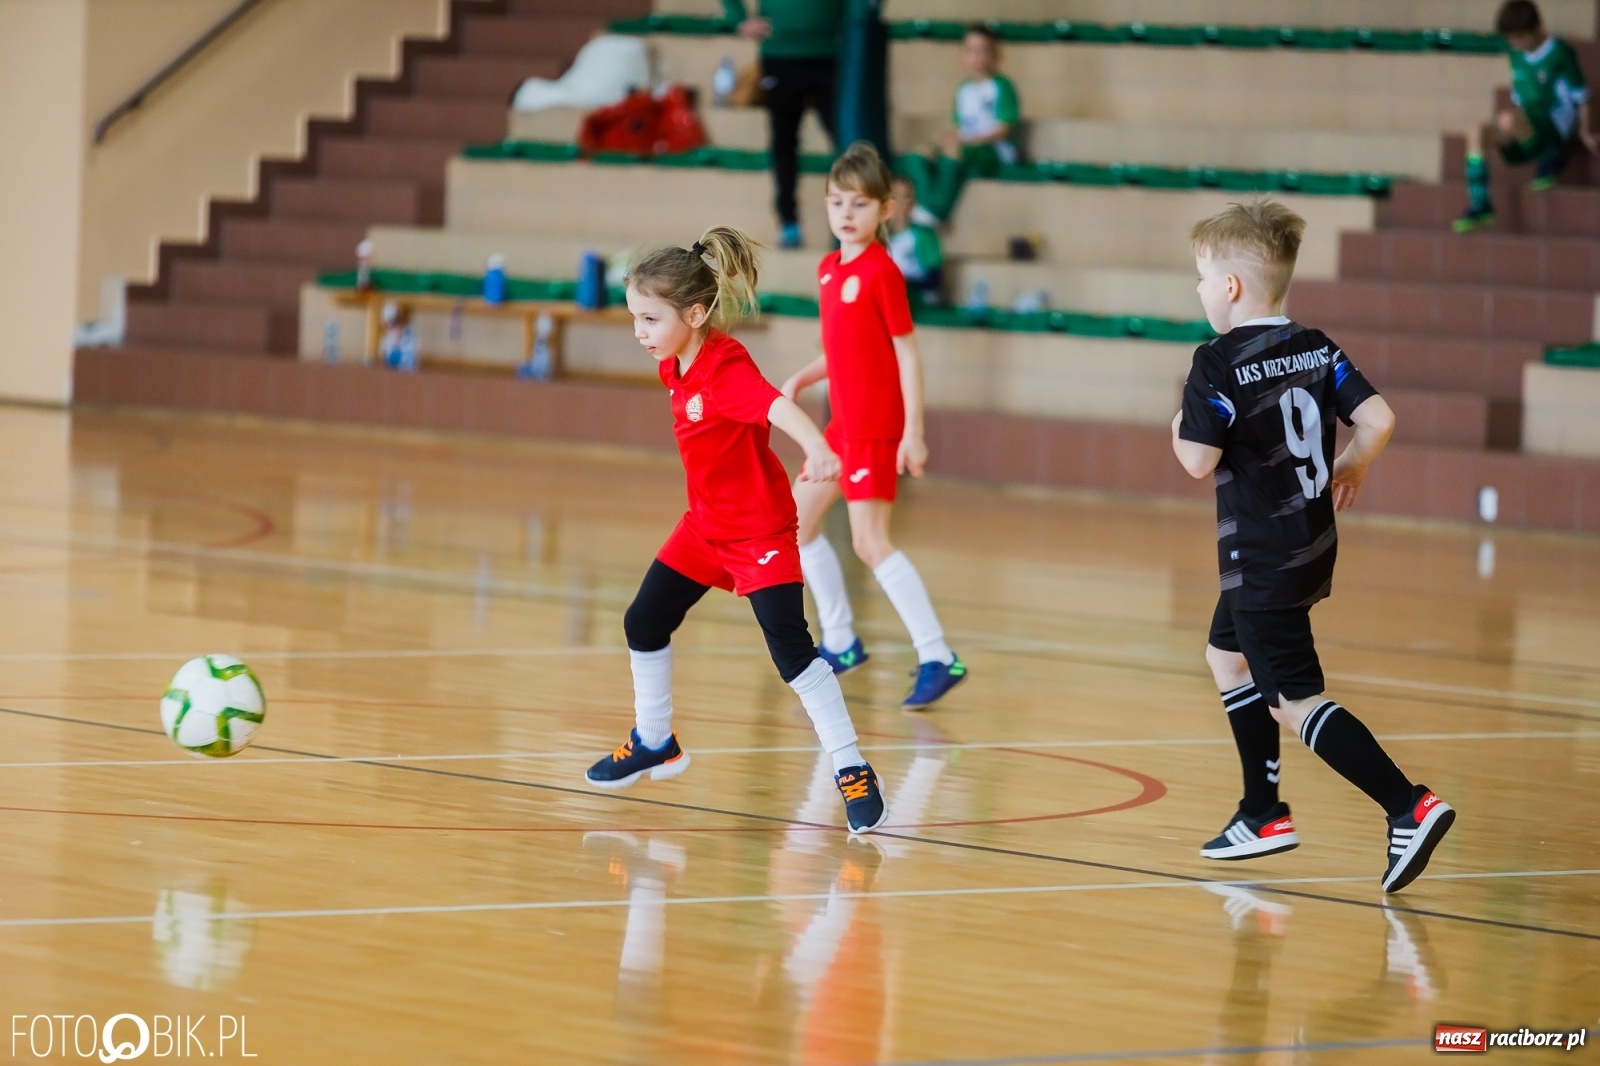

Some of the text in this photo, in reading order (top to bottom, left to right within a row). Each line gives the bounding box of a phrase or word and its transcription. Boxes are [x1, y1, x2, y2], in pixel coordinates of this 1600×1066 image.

[1235, 363, 1262, 386] LKS
[1279, 387, 1329, 500] 9
[838, 774, 856, 786] FILA
